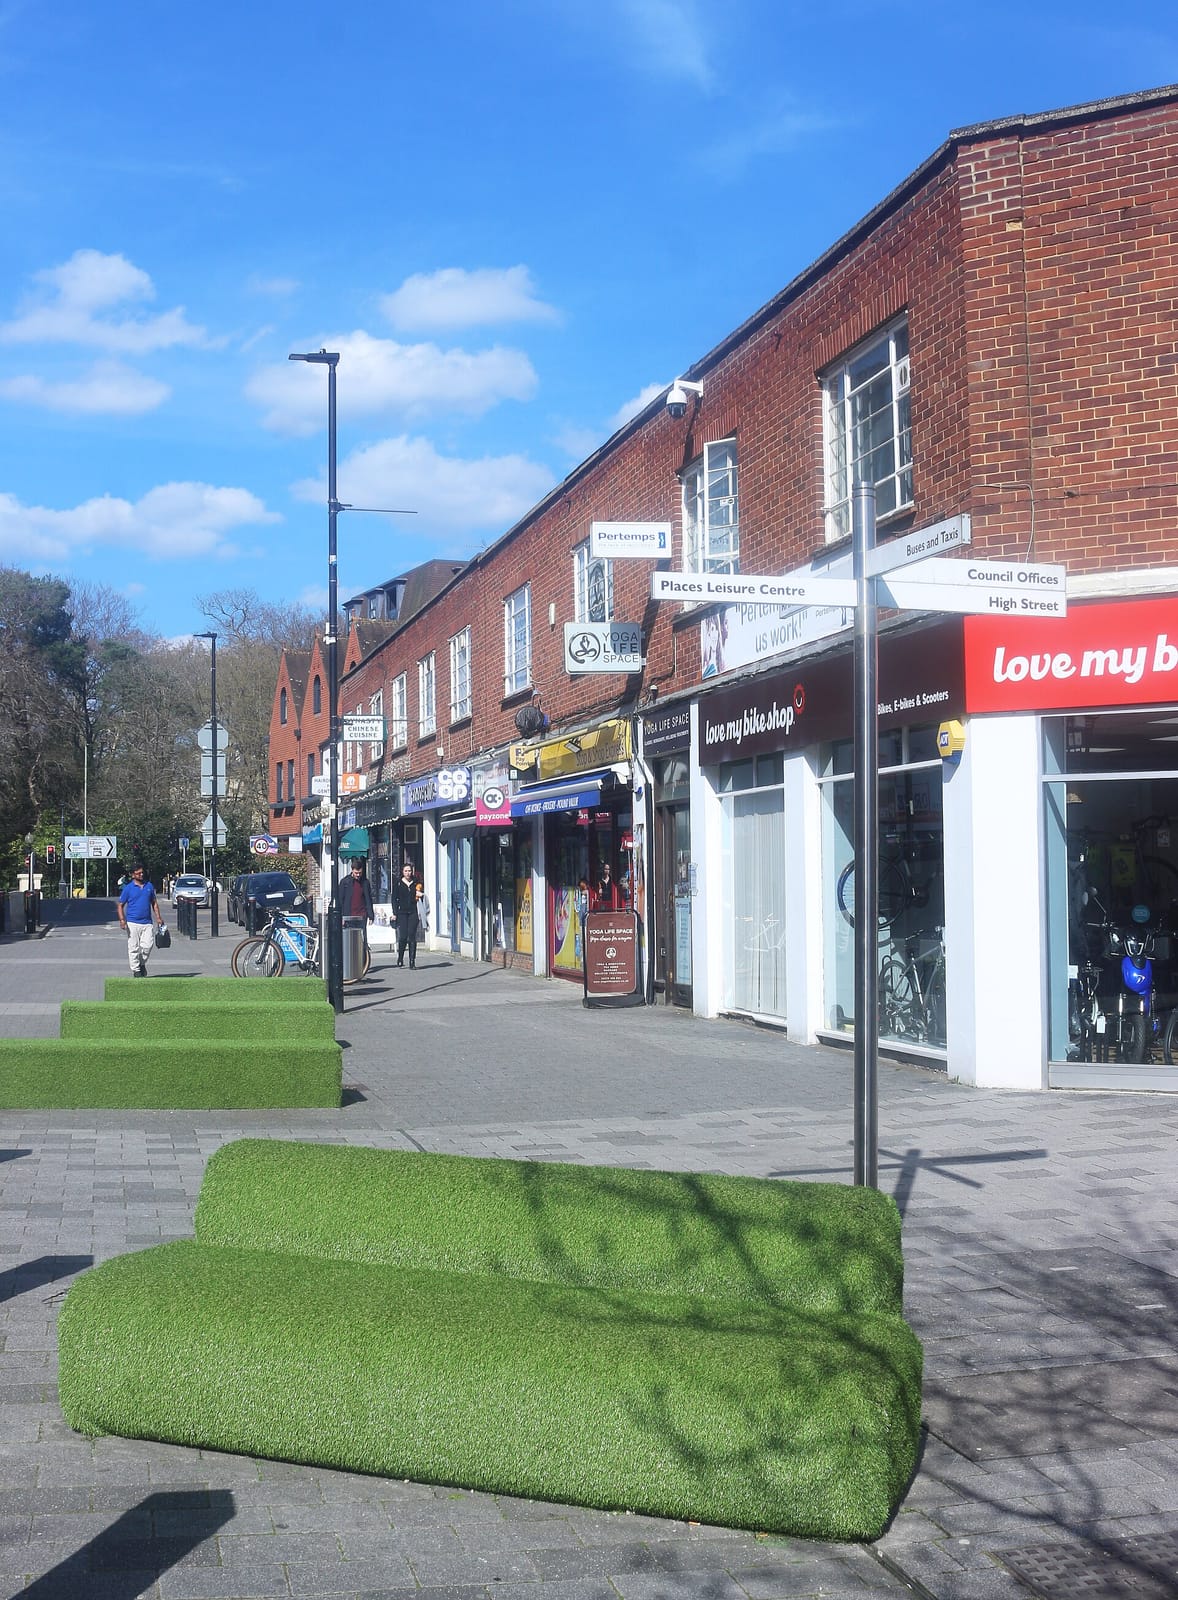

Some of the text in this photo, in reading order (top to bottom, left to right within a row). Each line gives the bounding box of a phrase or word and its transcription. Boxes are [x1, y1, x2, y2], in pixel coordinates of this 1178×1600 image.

[598, 532, 656, 542] Pertemps
[906, 529, 959, 557] Buses and Taxis
[967, 568, 1059, 585] Council Offices
[660, 580, 806, 597] Places Leisure Centre
[989, 597, 1059, 612] High Street
[602, 631, 638, 642] YOGA
[755, 632, 768, 653] us
[603, 643, 639, 653] LIFE
[603, 654, 639, 663] SPACE
[993, 646, 1076, 683] love
[1080, 646, 1148, 684] my
[894, 697, 915, 711] E-bikes
[916, 694, 922, 706] &
[922, 690, 949, 705] Scooters
[644, 712, 689, 735] YOGA LIFE SPACE
[705, 719, 726, 745] love
[726, 718, 743, 745] my
[479, 812, 509, 822] payzone
[256, 842, 267, 850] 40
